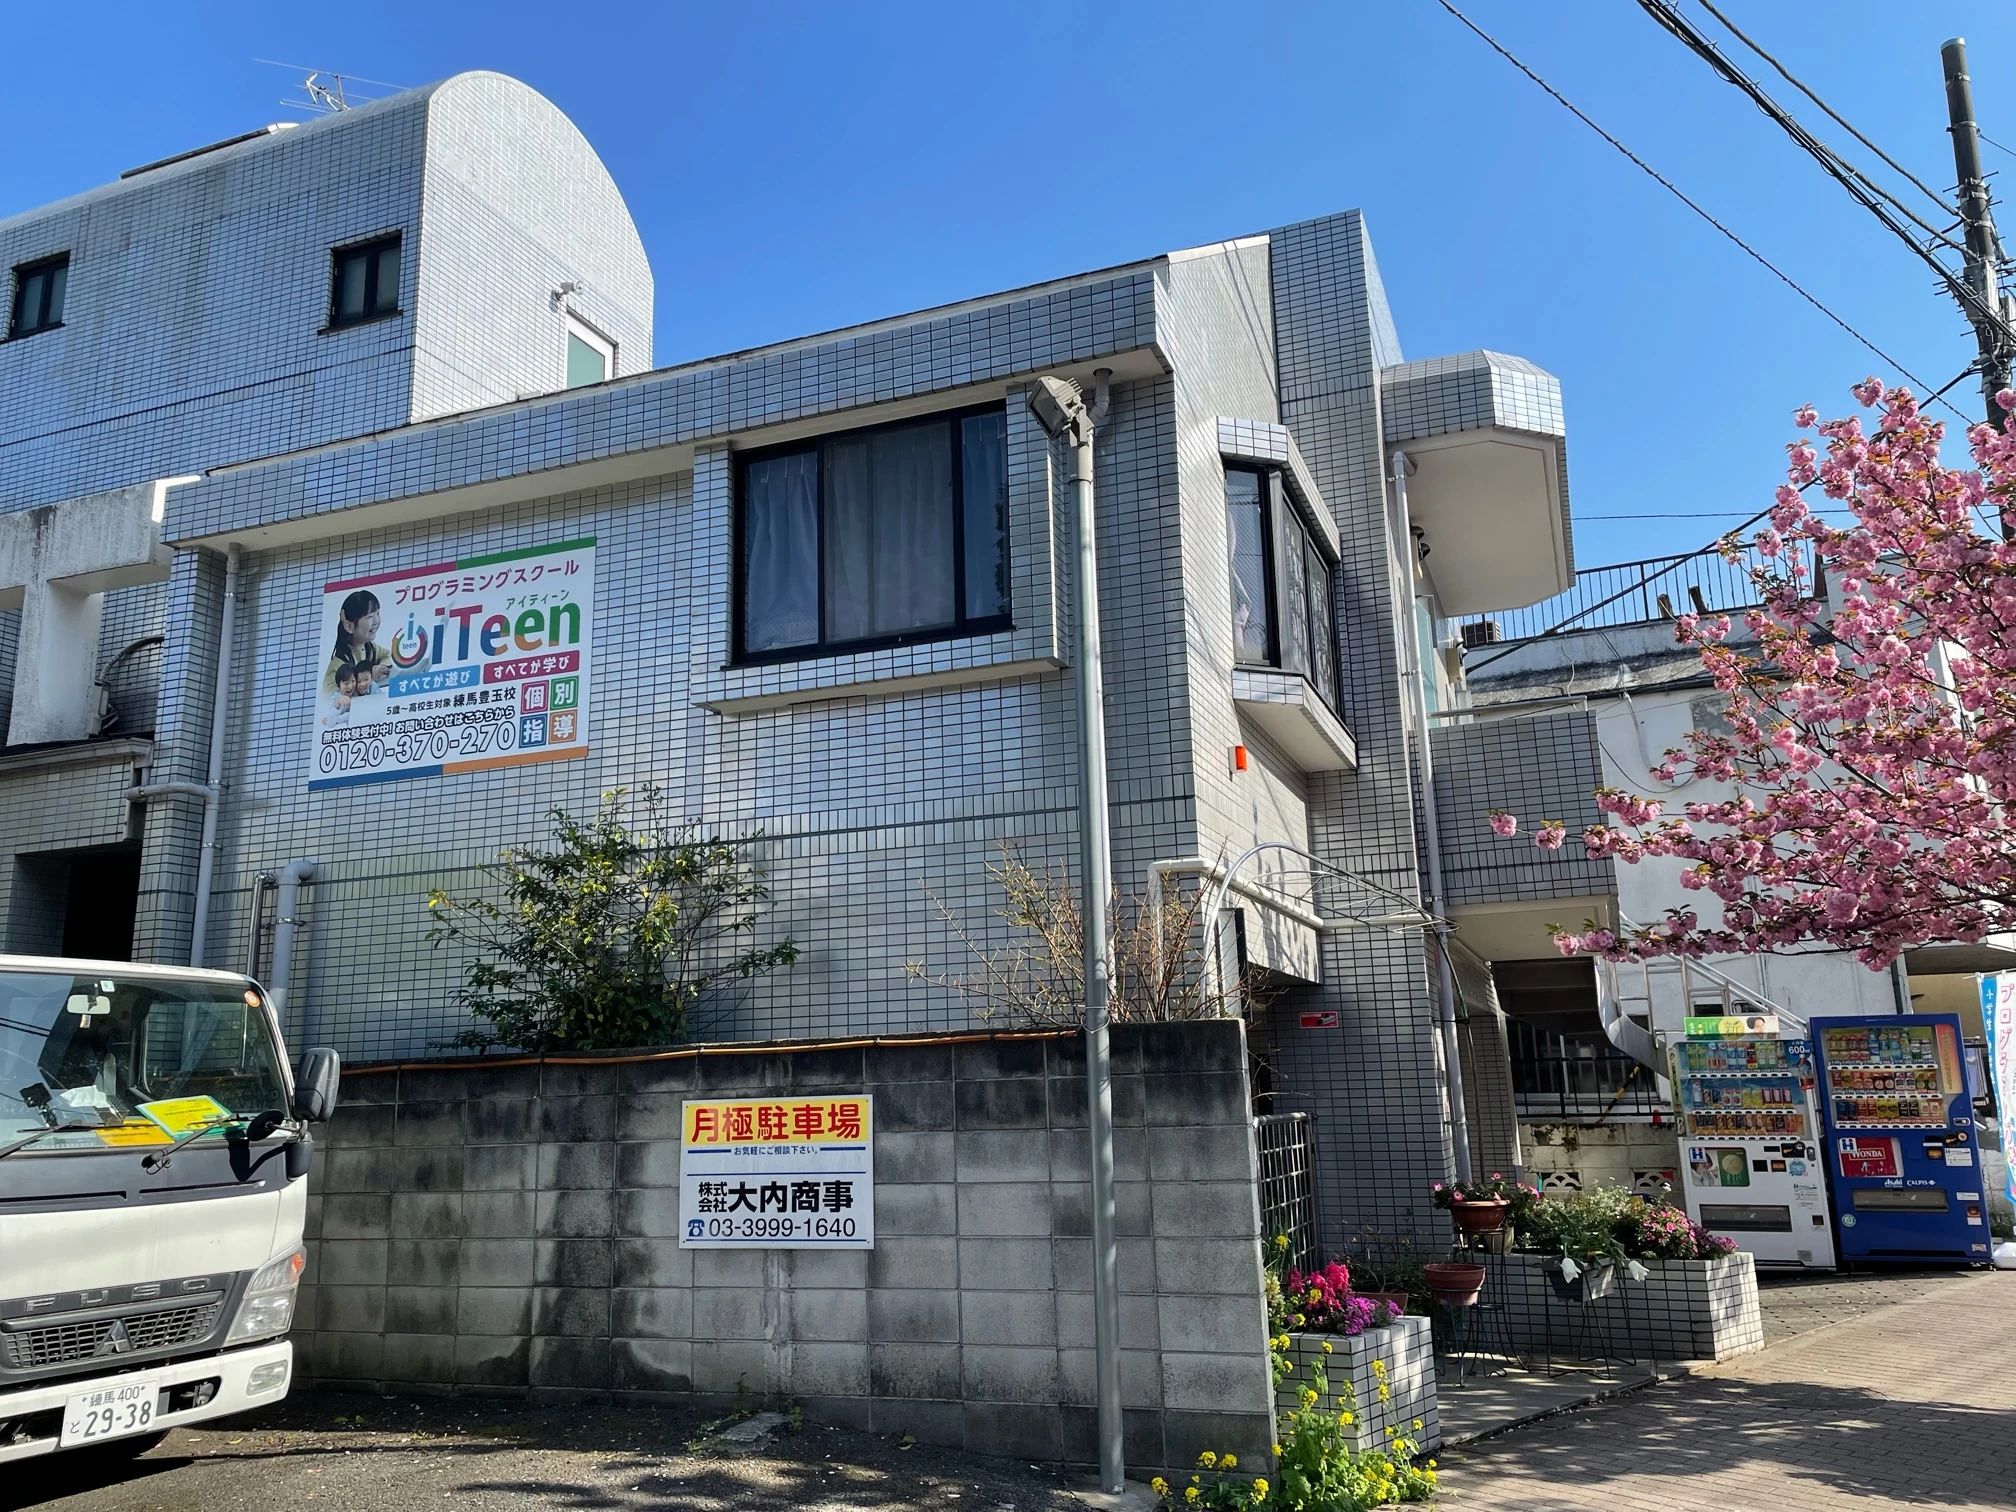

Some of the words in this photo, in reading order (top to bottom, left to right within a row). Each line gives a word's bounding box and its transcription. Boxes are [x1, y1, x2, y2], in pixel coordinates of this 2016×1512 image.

[395, 559, 580, 605] プログラミングスクール
[506, 589, 570, 610] アイティーン
[431, 602, 581, 665] iTeen
[402, 641, 418, 650] teen
[493, 655, 570, 679] すべてが学び
[398, 670, 472, 692] すべてが遊び
[453, 686, 517, 708] 練馬豊玉校
[395, 706, 516, 736] お問い合わせはこちらから
[319, 721, 517, 773] 0120-370-270
[691, 1103, 861, 1143] 月極駐車場
[733, 1145, 819, 1156] お気軽にご相談下さい。
[1852, 1148, 1883, 1159] WONDA
[698, 1182, 728, 1197] 株式
[727, 1180, 854, 1213] 大内商事
[698, 1197, 727, 1213] 会社
[708, 1217, 856, 1238] 03-3999-1640
[26, 1277, 211, 1313] FUSO
[89, 1390, 116, 1407] 練馬
[117, 1386, 140, 1402] 400
[70, 1420, 80, 1434] と
[83, 1400, 152, 1438] 29-38
